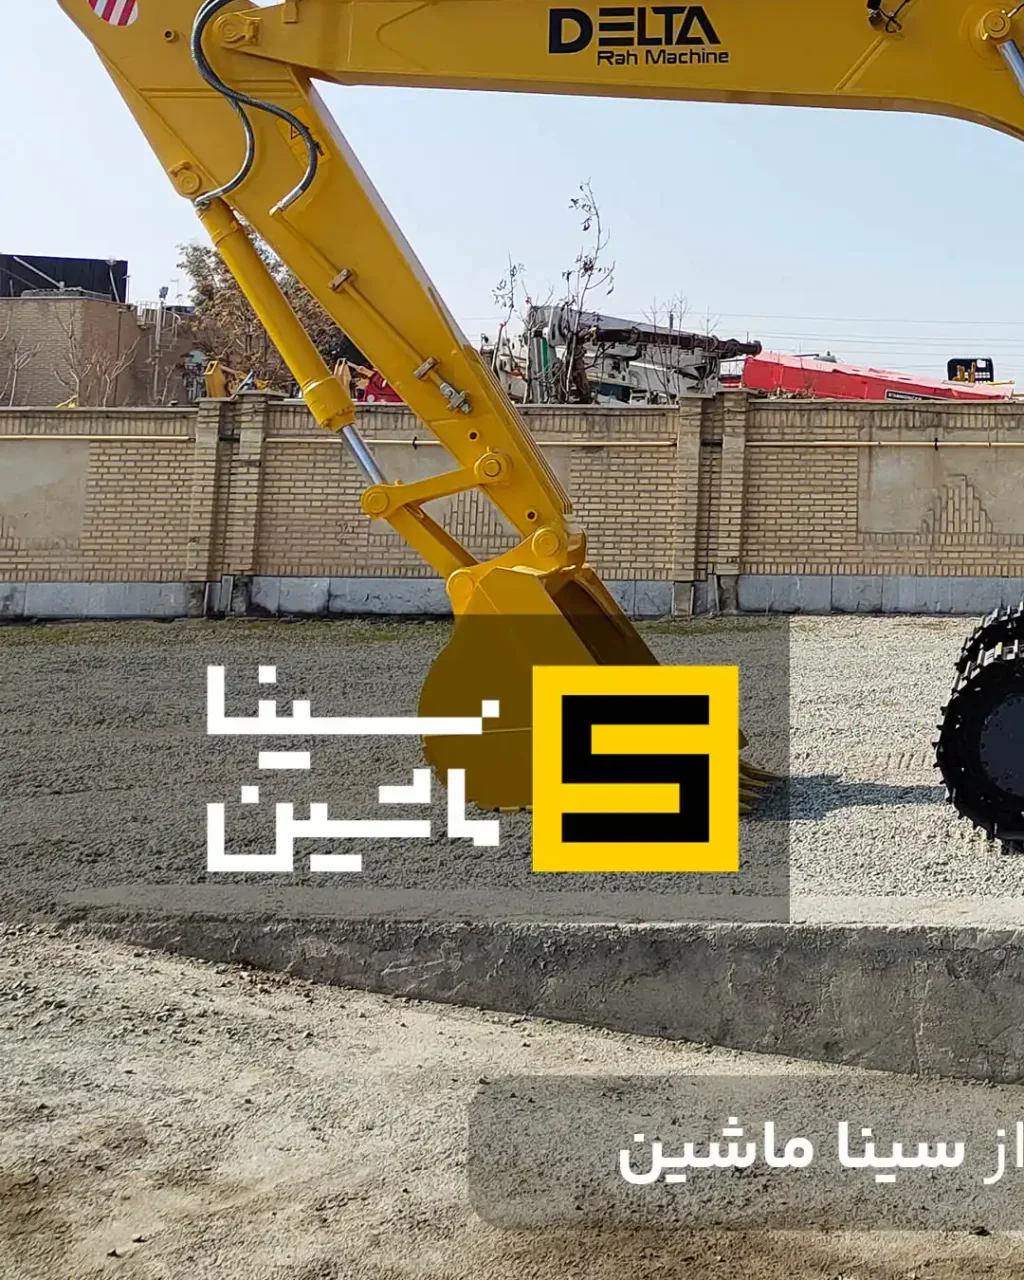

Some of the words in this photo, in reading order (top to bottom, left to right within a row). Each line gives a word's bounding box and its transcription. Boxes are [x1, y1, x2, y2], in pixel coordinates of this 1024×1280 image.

[549, 6, 721, 54] DELTA
[597, 50, 638, 66] Rah
[645, 47, 729, 65] Machine
